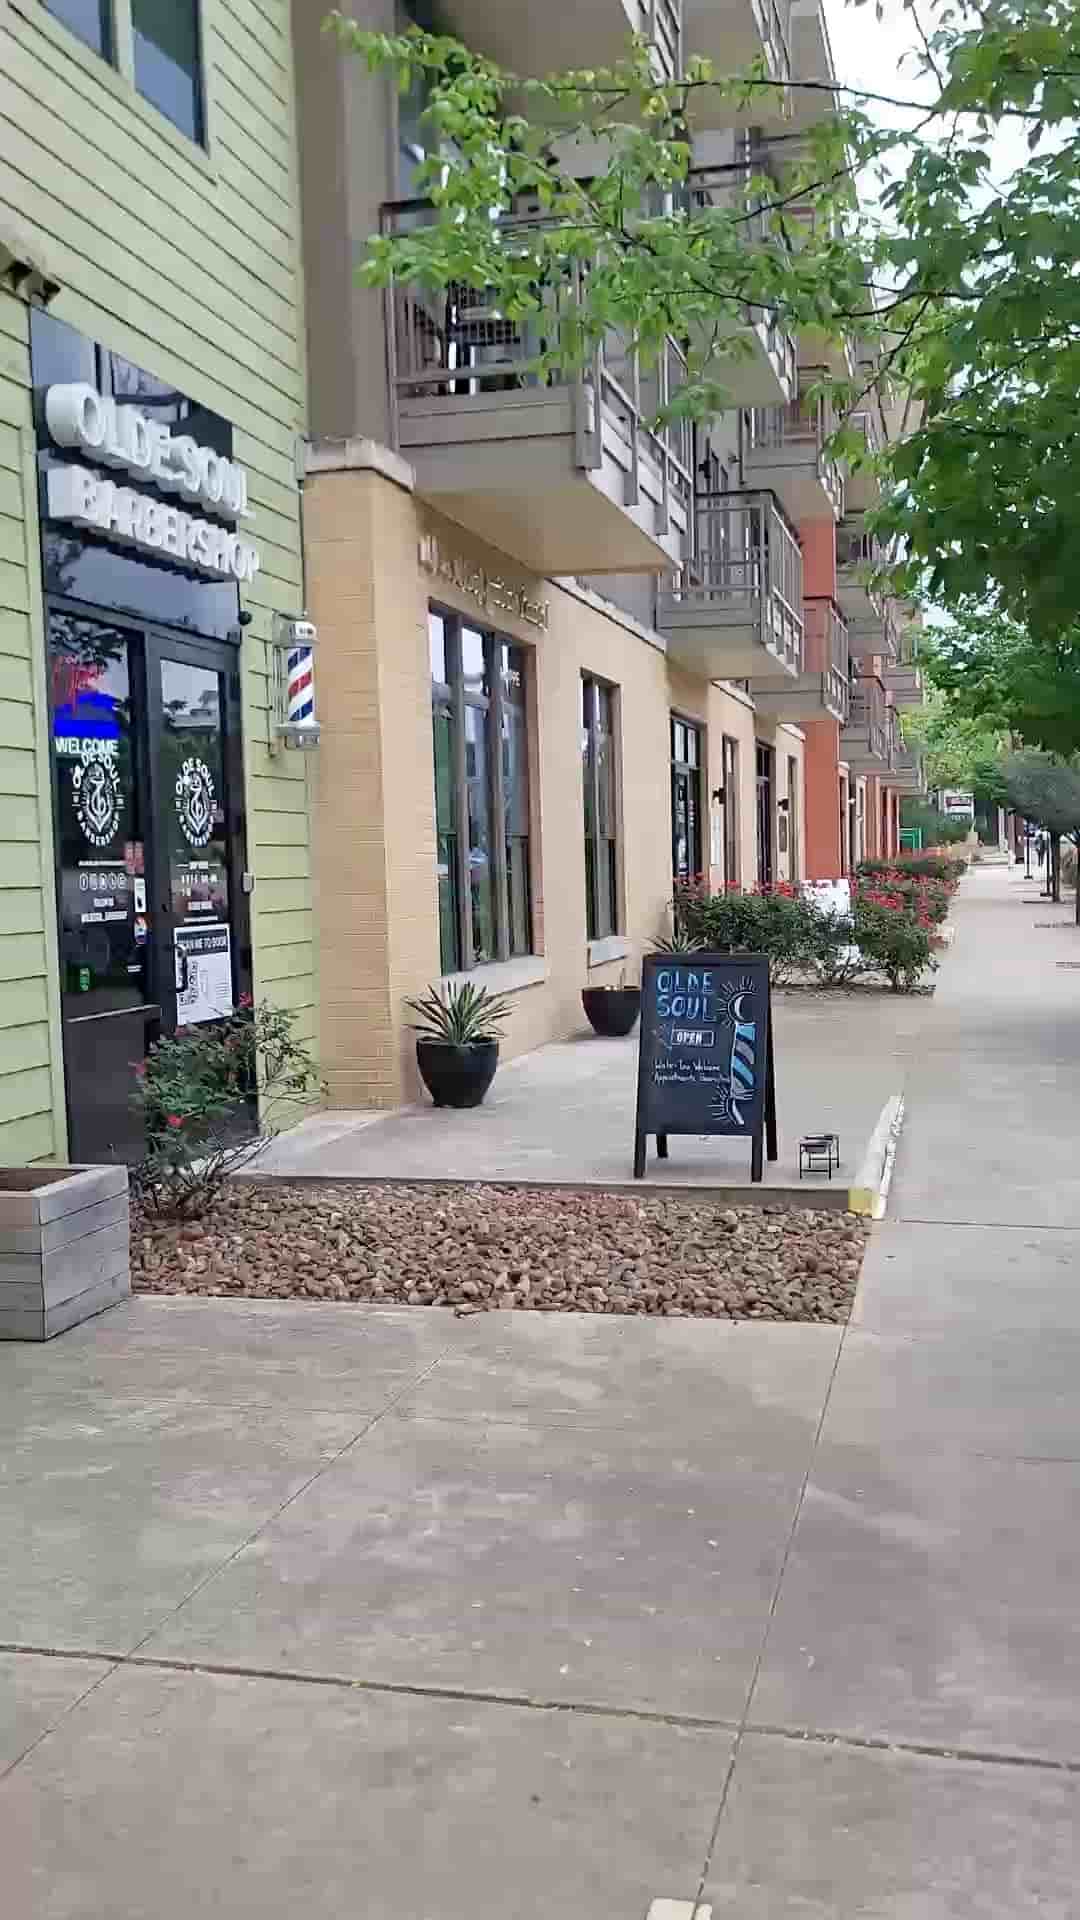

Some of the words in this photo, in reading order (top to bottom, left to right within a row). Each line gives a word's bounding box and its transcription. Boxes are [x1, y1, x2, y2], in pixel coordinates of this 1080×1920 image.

[46, 382, 172, 478] OLDE
[160, 434, 256, 521] SOUL
[47, 464, 260, 584] BARBERSHOP
[55, 737, 119, 756] WELCOME
[657, 970, 713, 993] OLDE
[657, 994, 717, 1022] SOUL
[676, 1031, 703, 1046] OPEN
